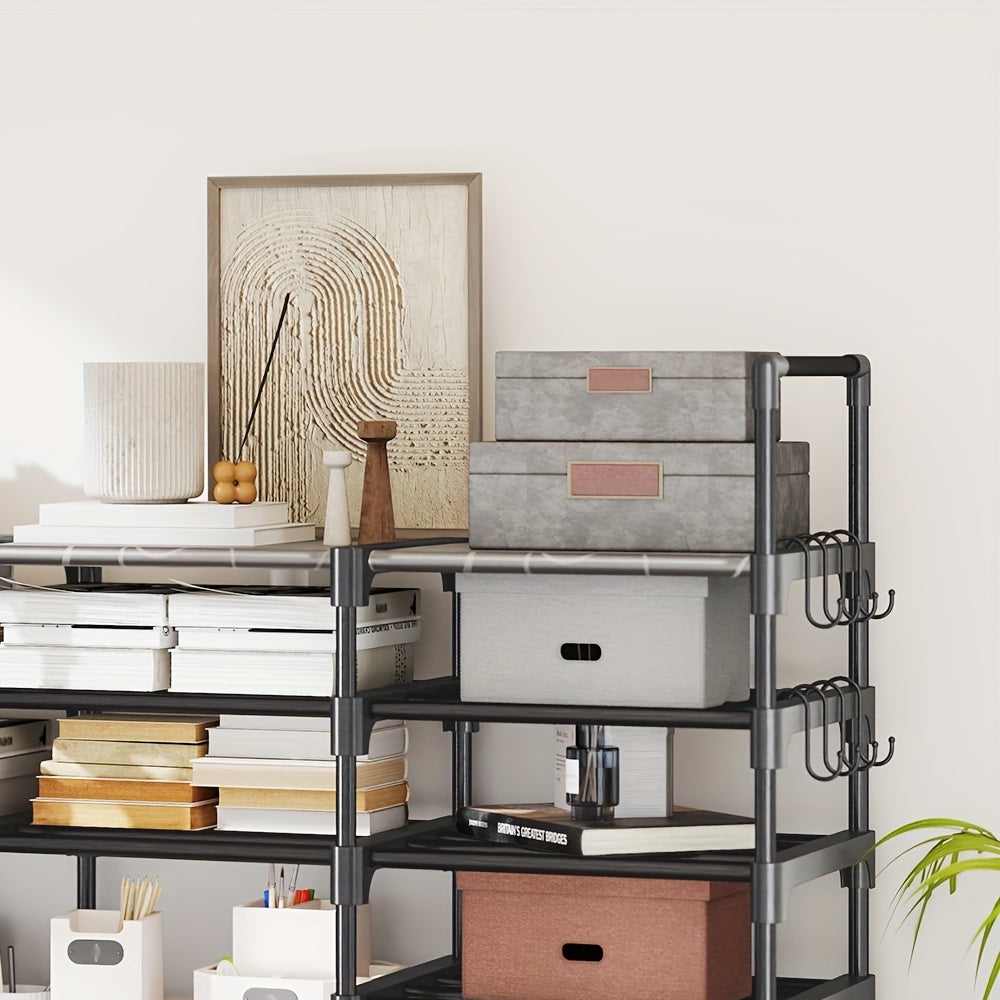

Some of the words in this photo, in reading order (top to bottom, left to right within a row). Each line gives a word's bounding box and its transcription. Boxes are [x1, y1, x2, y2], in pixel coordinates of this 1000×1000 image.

[497, 821, 521, 837] BRITAIN'S
[520, 826, 546, 842] GREATEST
[545, 830, 568, 846] BRIDGES
